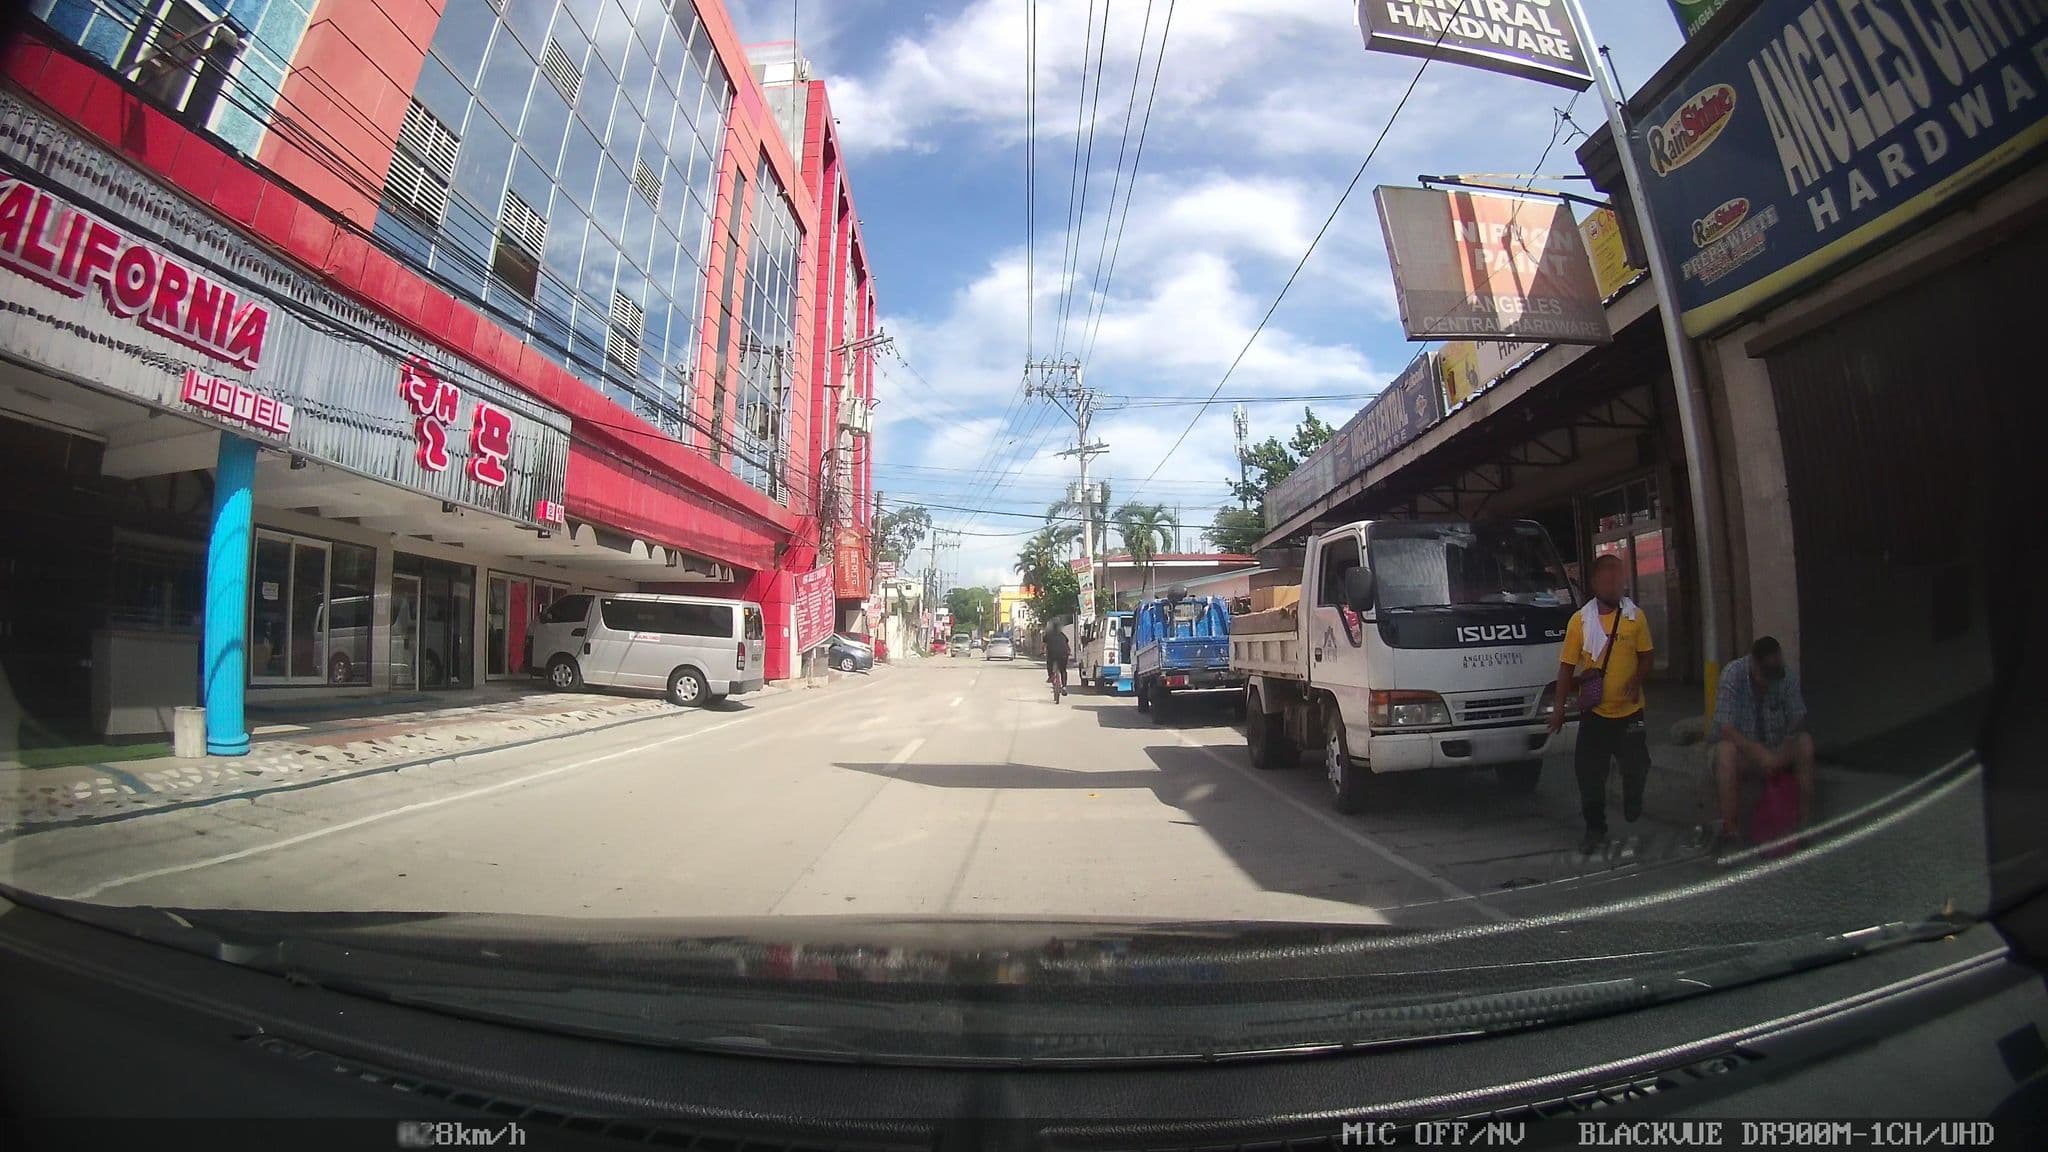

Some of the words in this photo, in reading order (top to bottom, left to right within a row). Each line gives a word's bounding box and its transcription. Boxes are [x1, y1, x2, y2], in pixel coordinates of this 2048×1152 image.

[1386, 4, 1574, 61] HARDWARE
[1688, 6, 1715, 37] HIGH
[1748, 0, 1931, 197] ANGELES
[0, 174, 268, 368] ALIFORNIA
[1474, 248, 1569, 277] PAINT
[1470, 295, 1562, 315] ANGELES
[1423, 315, 1504, 334] CENTRAL
[1510, 318, 1602, 337] HARDWARE
[193, 374, 291, 430] HOTEL
[1457, 624, 1527, 642] ISUZU
